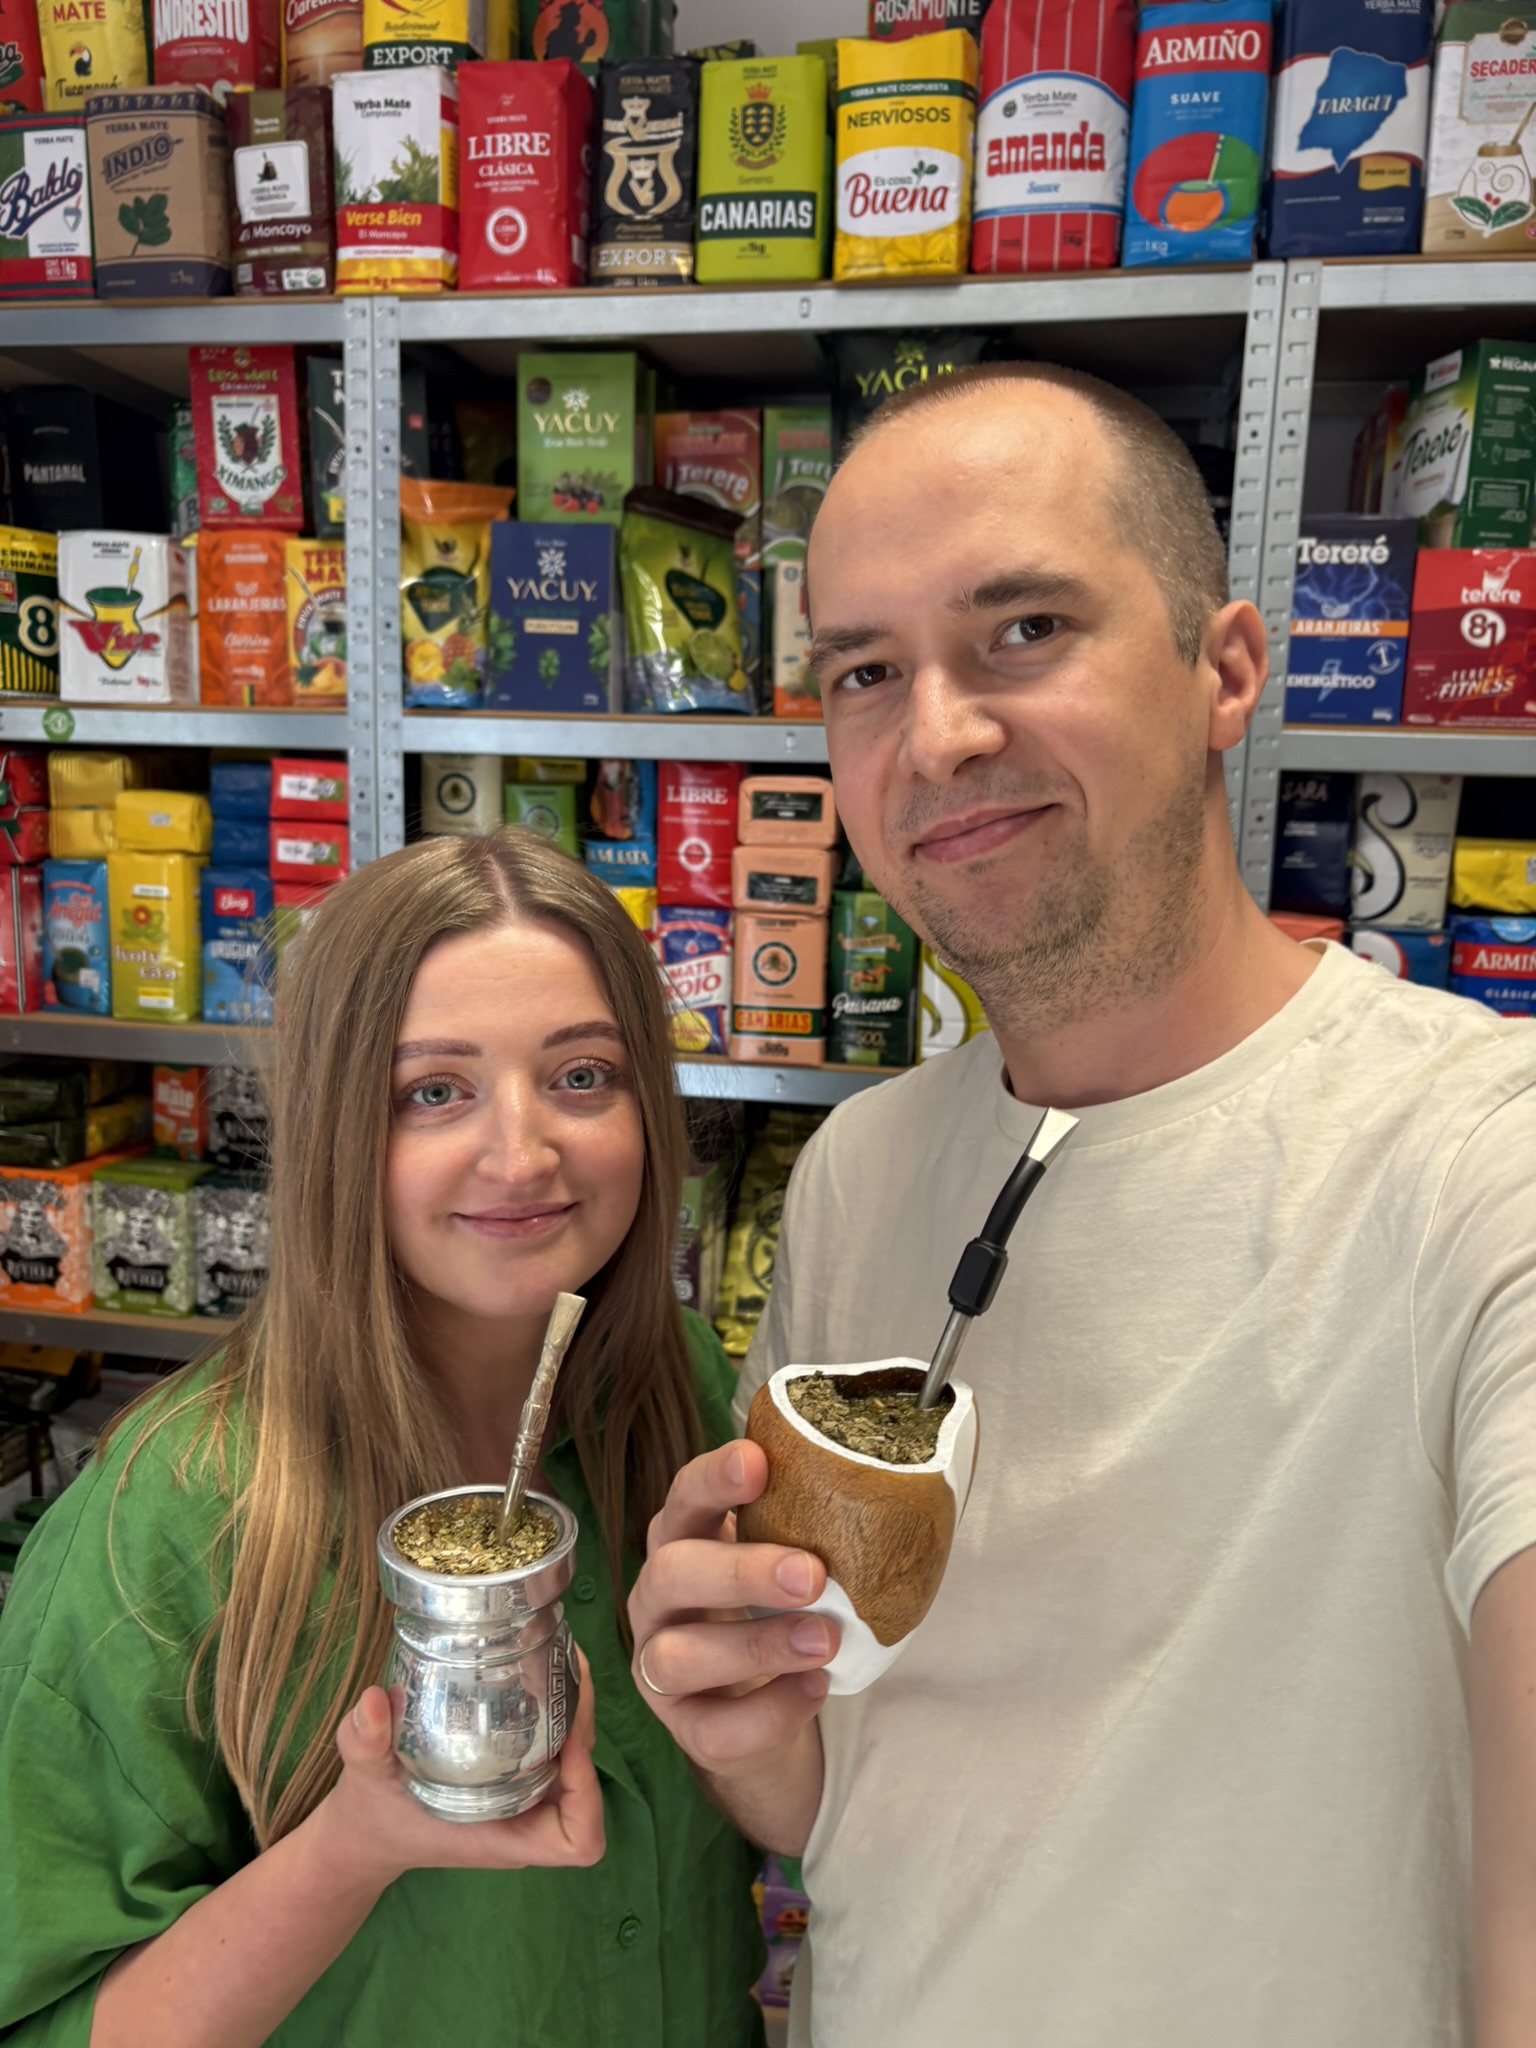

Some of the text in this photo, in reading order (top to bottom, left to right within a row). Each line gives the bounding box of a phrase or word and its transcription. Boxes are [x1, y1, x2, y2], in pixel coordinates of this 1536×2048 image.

[52, 1, 107, 24] MATE
[373, 46, 454, 66] EXPORT
[1142, 29, 1261, 69] ARMIÑO
[384, 98, 412, 110] Mate
[1170, 90, 1221, 106] SUAVE
[139, 120, 170, 131] MATE
[846, 106, 951, 130] NERVIOSOS
[104, 135, 172, 179] INDIO
[467, 131, 551, 161] LIBRE
[987, 120, 1106, 178] amanda
[478, 160, 535, 178] CLÁSICA
[0, 156, 83, 233] Baldo
[844, 169, 949, 219] Buena
[346, 207, 422, 227] Verse Bien
[701, 199, 814, 232] CANARIAS
[252, 223, 312, 240] Moncayo
[597, 247, 684, 268] EXPORT
[855, 362, 953, 397] YAC
[533, 411, 621, 434] YACUY
[23, 462, 87, 485] PANTANAL
[215, 463, 288, 491] XIMANGO
[1298, 535, 1390, 565] Tereré
[506, 576, 598, 602] YACUY
[207, 597, 287, 613] LARANJEIRAS
[1294, 620, 1381, 635] ARANJEIRAS
[1468, 612, 1500, 648] 81
[1438, 674, 1517, 700] FITNESS
[666, 785, 729, 806] LIBRE
[669, 960, 713, 979] MATE
[734, 1008, 813, 1033] CANARIAS
